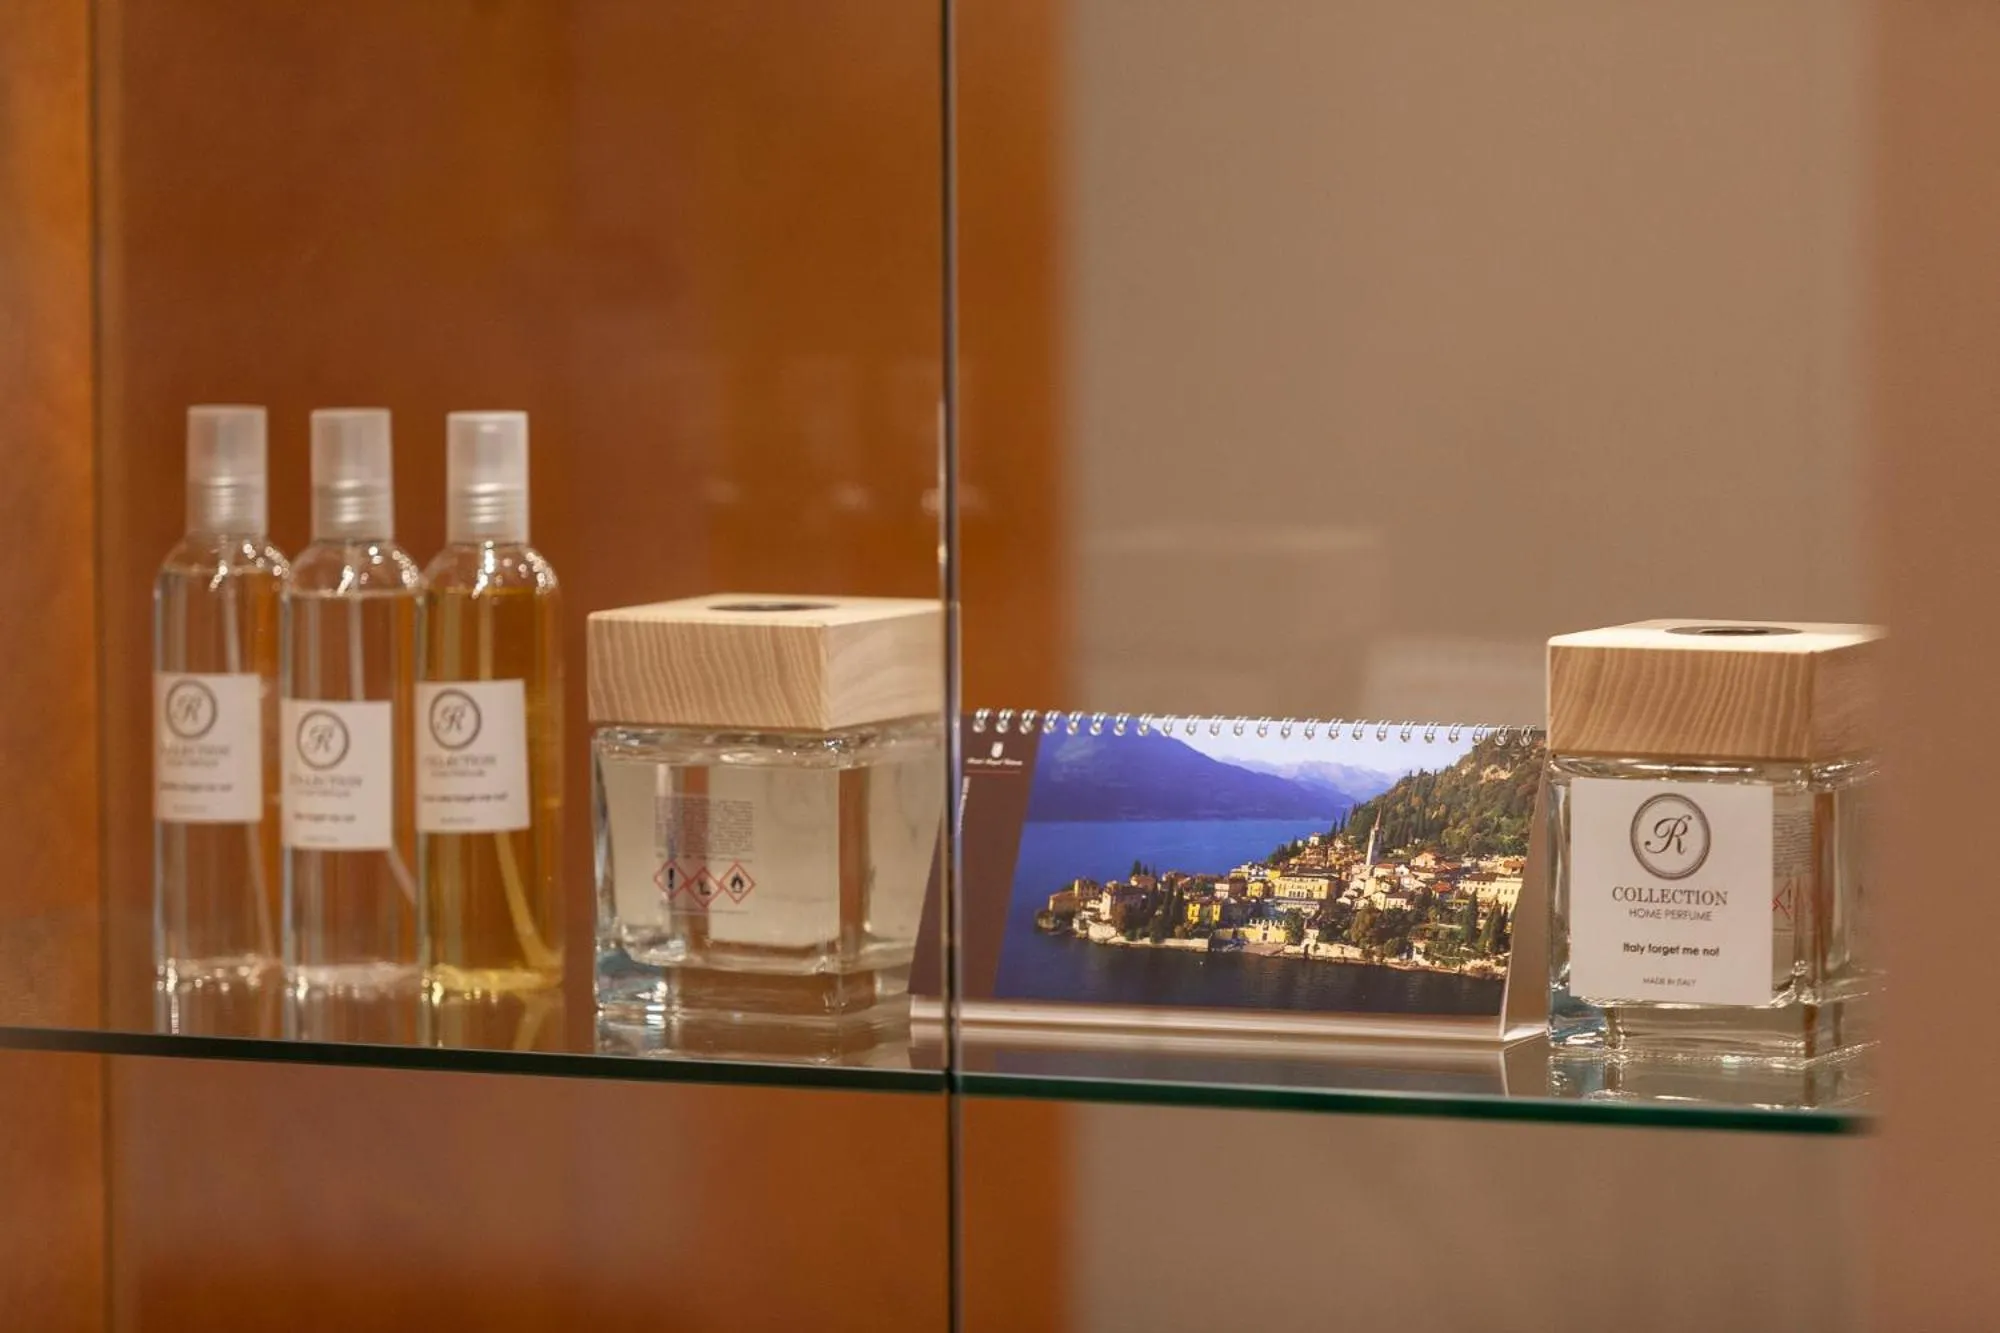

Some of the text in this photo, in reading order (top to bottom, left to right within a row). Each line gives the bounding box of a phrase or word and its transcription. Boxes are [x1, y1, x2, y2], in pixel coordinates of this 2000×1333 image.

[1644, 814, 1693, 856] R
[1612, 886, 1729, 906] COLLECTION
[1628, 907, 1713, 921] HOME PERFUME
[1623, 942, 1720, 957] Italy forget me not
